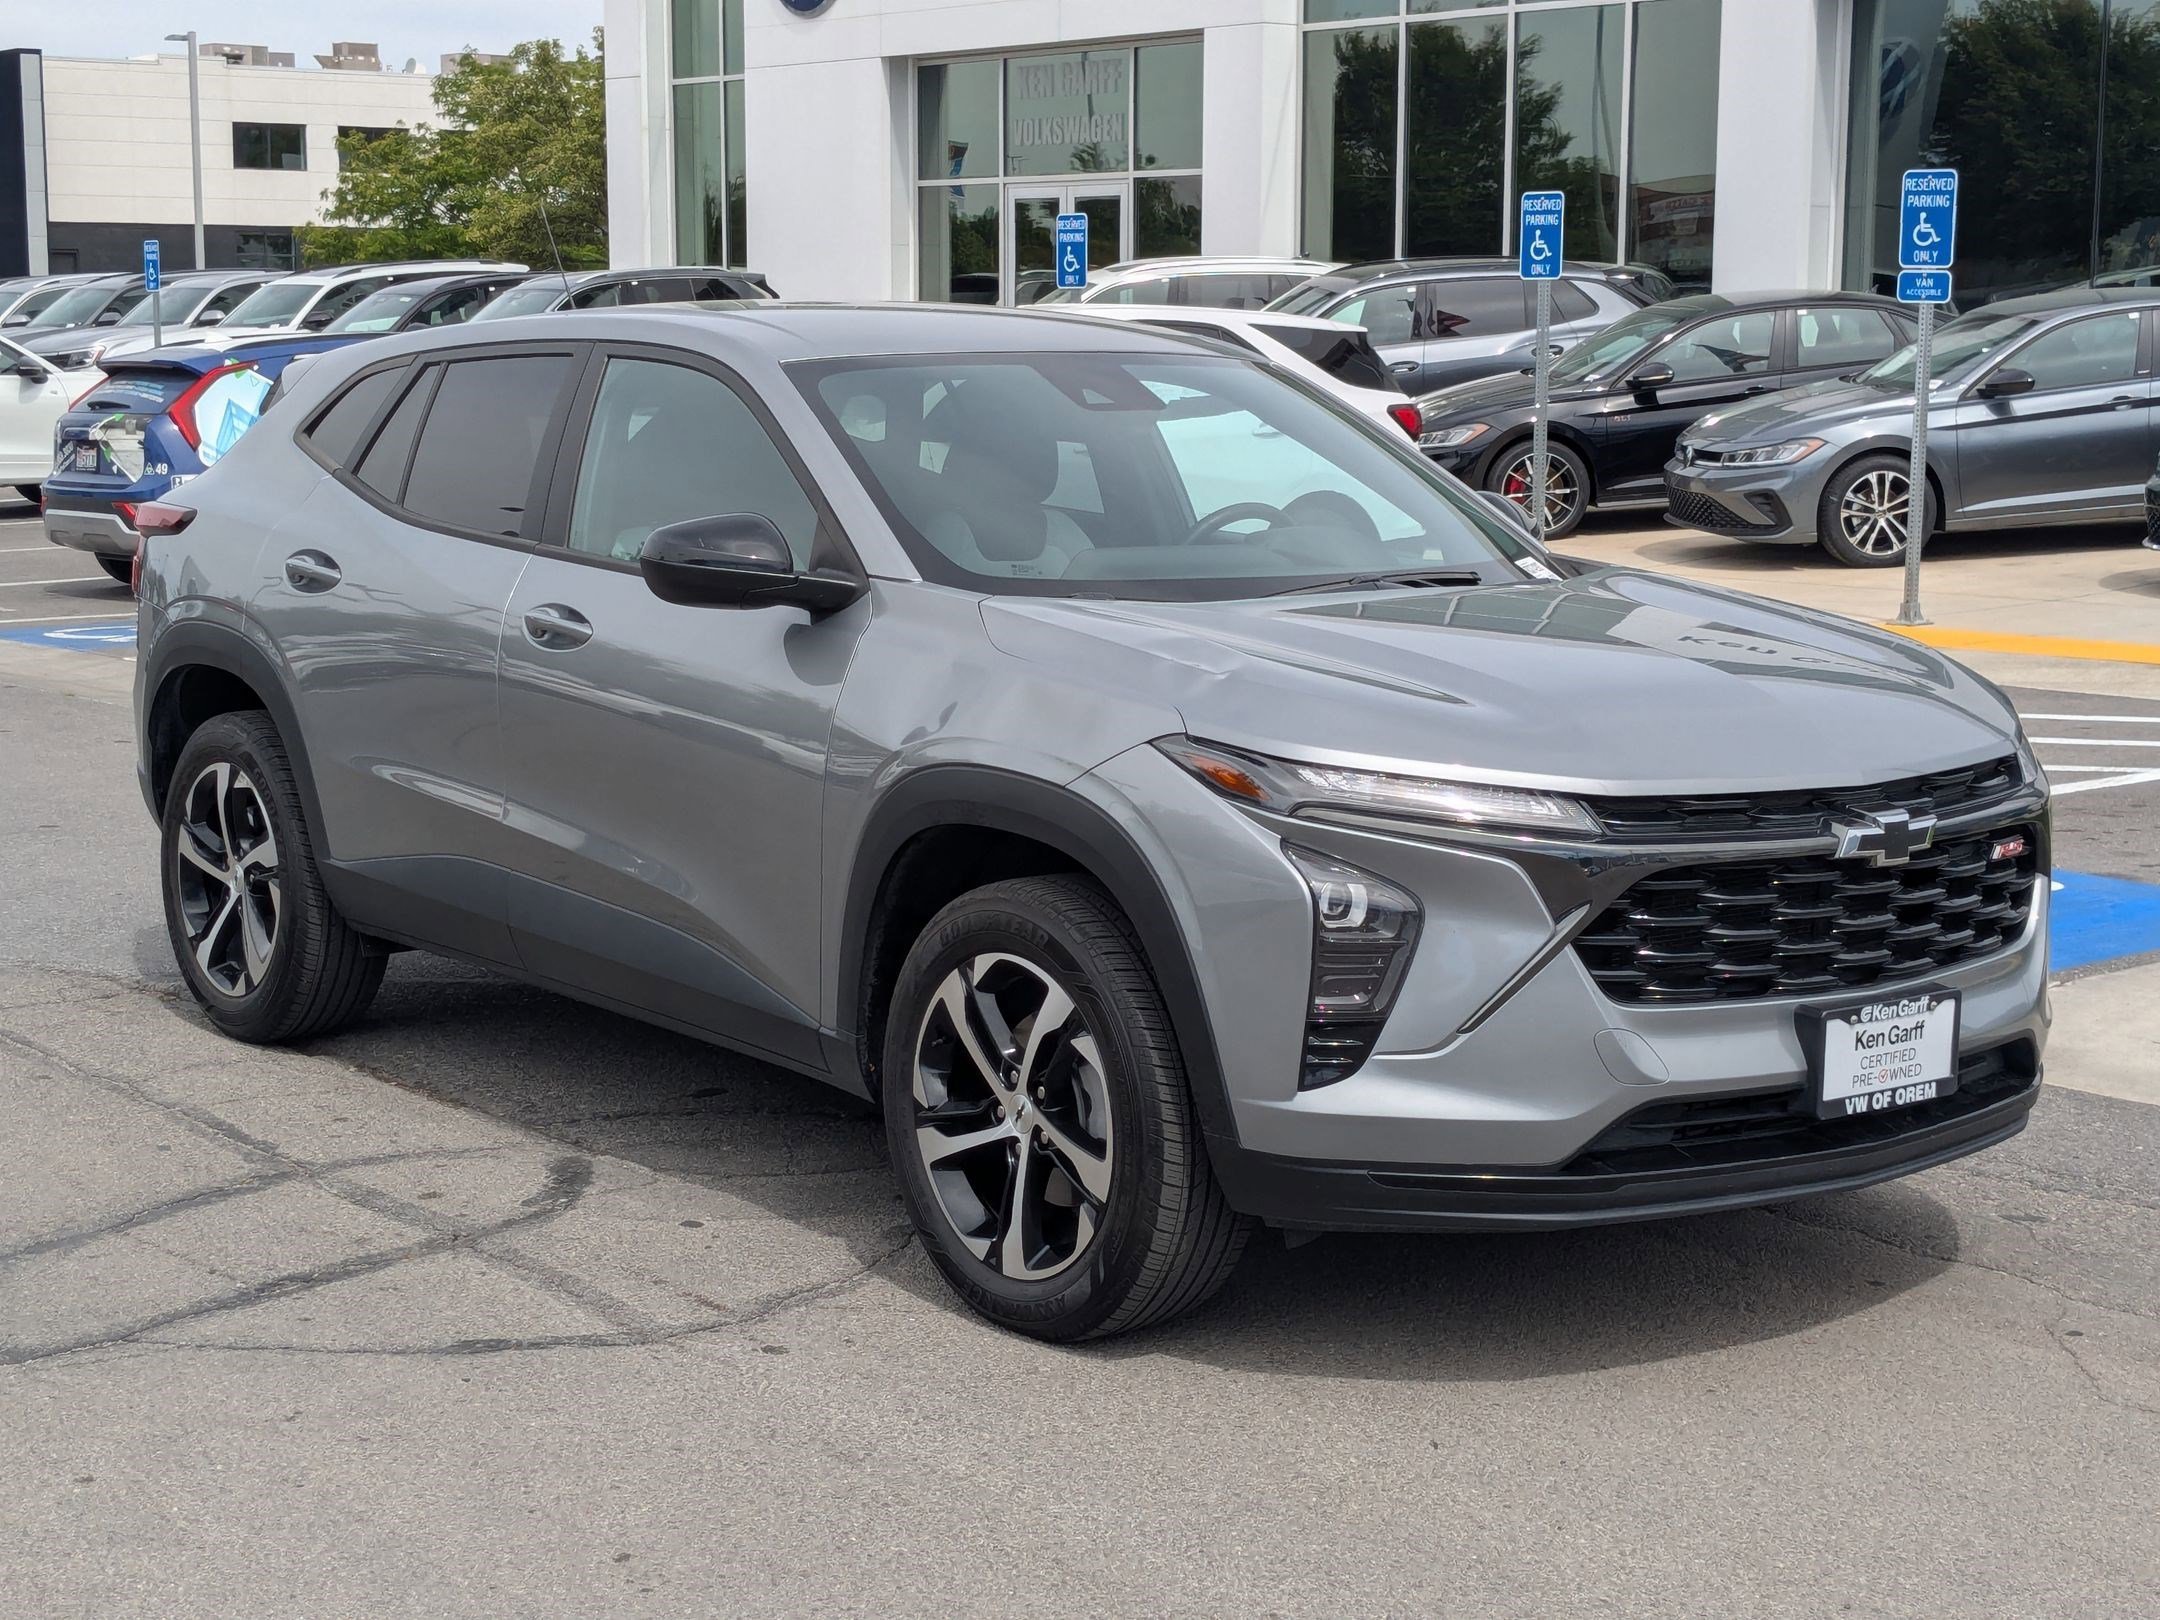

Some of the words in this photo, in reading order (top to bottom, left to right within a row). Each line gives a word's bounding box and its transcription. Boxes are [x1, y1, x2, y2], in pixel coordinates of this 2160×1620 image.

[1018, 64, 1055, 99] KEN
[1014, 113, 1125, 146] VOLKSWAGEN
[1905, 178, 1954, 190] RESERVED
[1523, 199, 1561, 211] RESERVED
[1907, 195, 1950, 208] PARKING
[1525, 214, 1559, 226] PARKING
[1913, 250, 1939, 263] ONLY
[1531, 264, 1551, 275] ONLY
[1915, 278, 1934, 288] VAN
[155, 463, 168, 475] 49
[1872, 1002, 1898, 1020] Ken
[1898, 995, 1930, 1017] Garff
[1854, 1029, 1885, 1051] Ken
[1888, 1020, 1925, 1045] Garff
[1860, 1047, 1916, 1070] CERTIFIED
[1845, 1095, 1868, 1115] VW
[1871, 1091, 1892, 1110] OF
[1895, 1081, 1937, 1105] OREM
